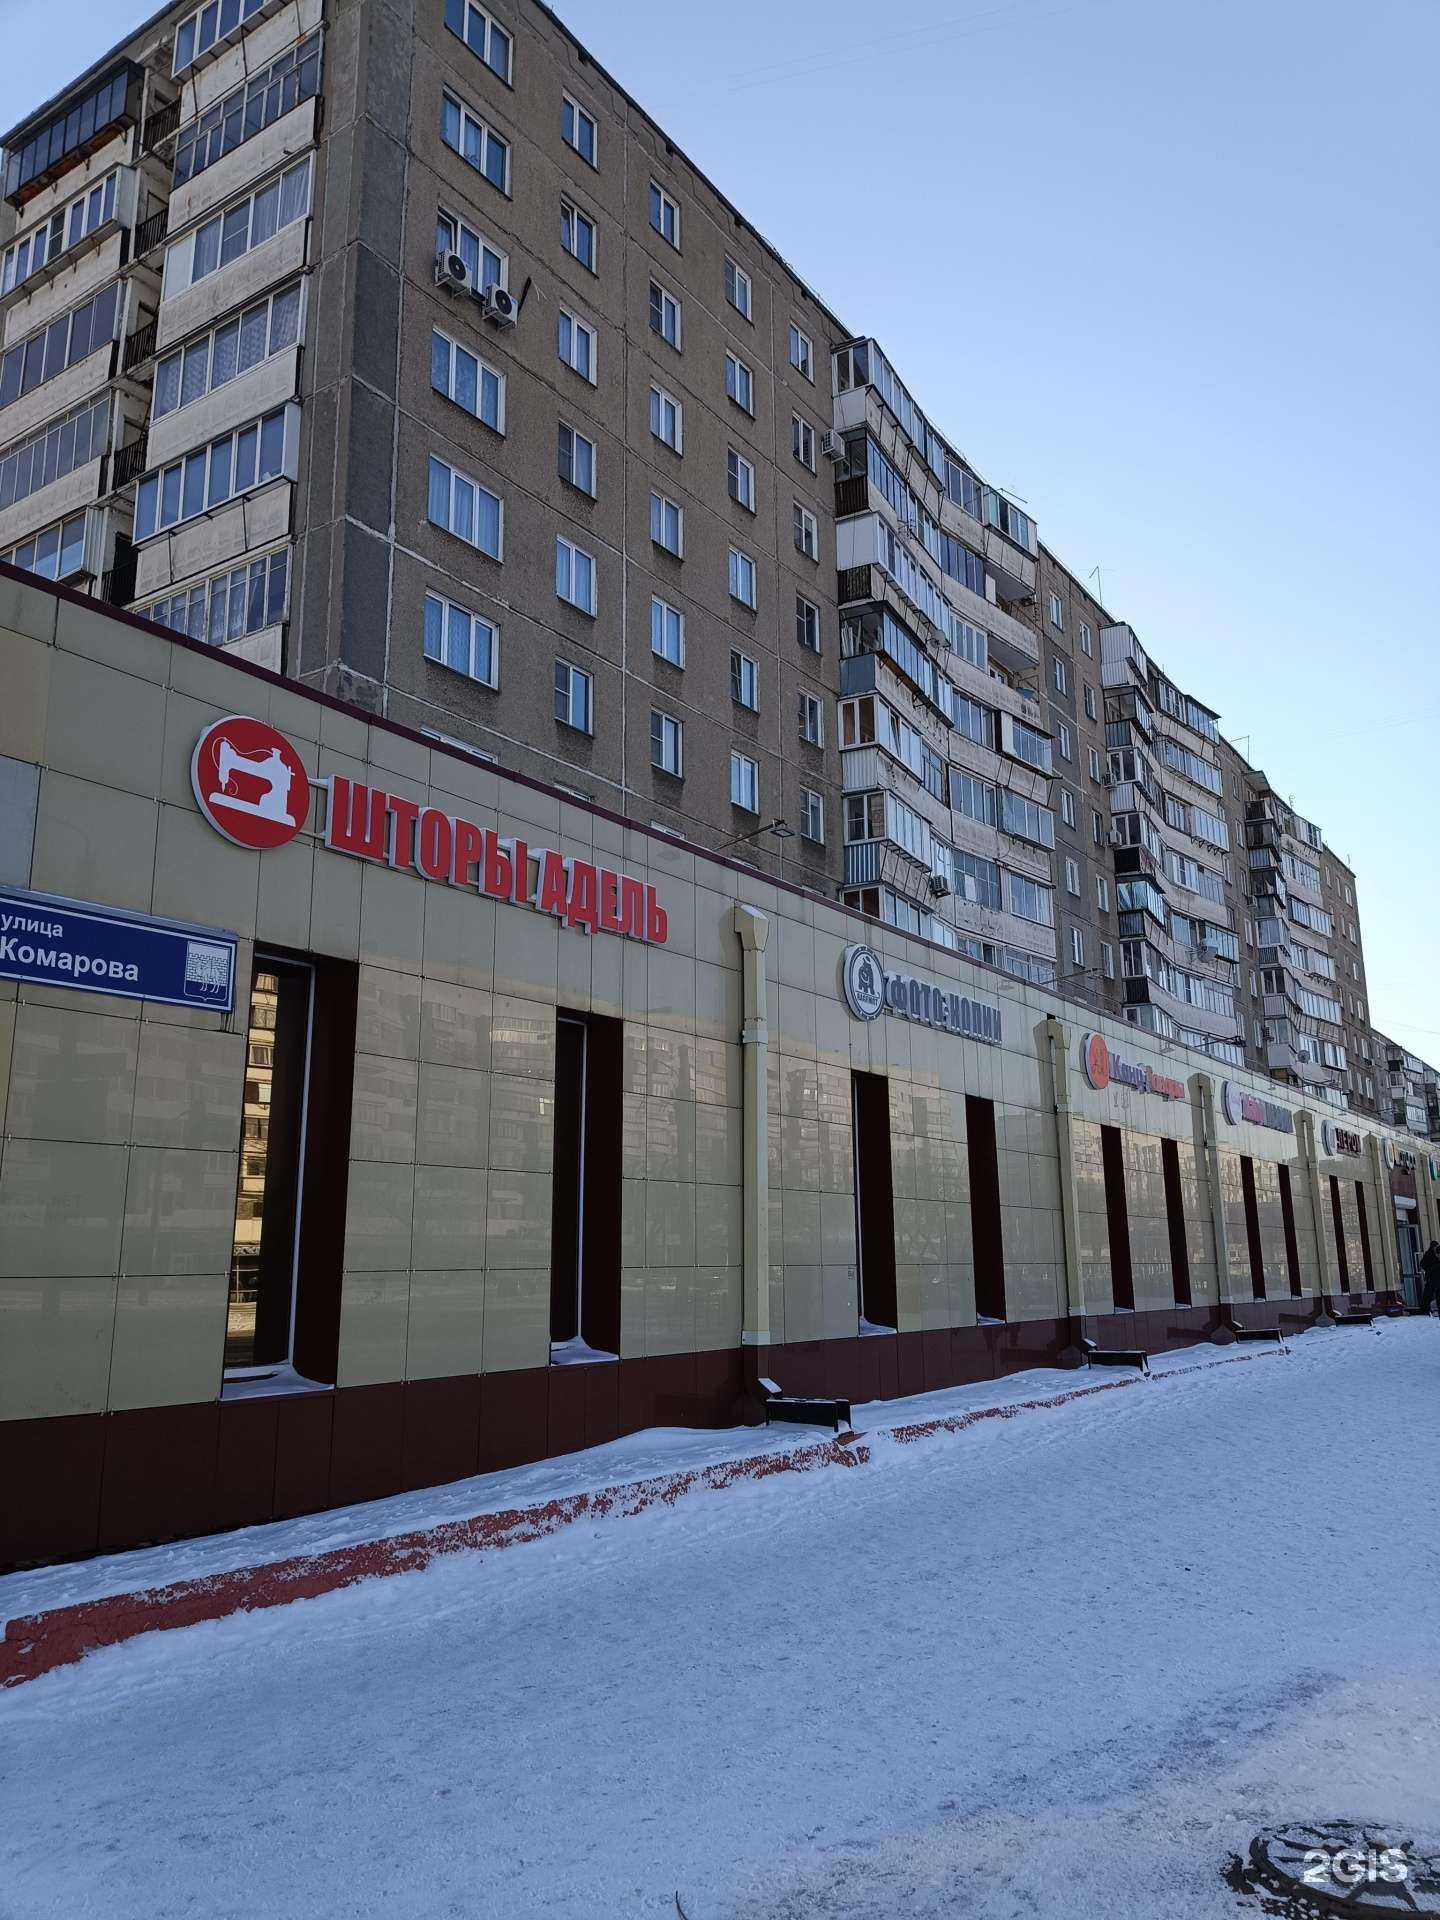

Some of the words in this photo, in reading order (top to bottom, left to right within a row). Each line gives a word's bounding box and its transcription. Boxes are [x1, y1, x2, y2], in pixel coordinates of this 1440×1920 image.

[326, 775, 528, 903] ШТОРЫ
[536, 849, 668, 944] АДЕЛЬ
[1, 913, 64, 938] улица
[0, 936, 140, 982] Комарова
